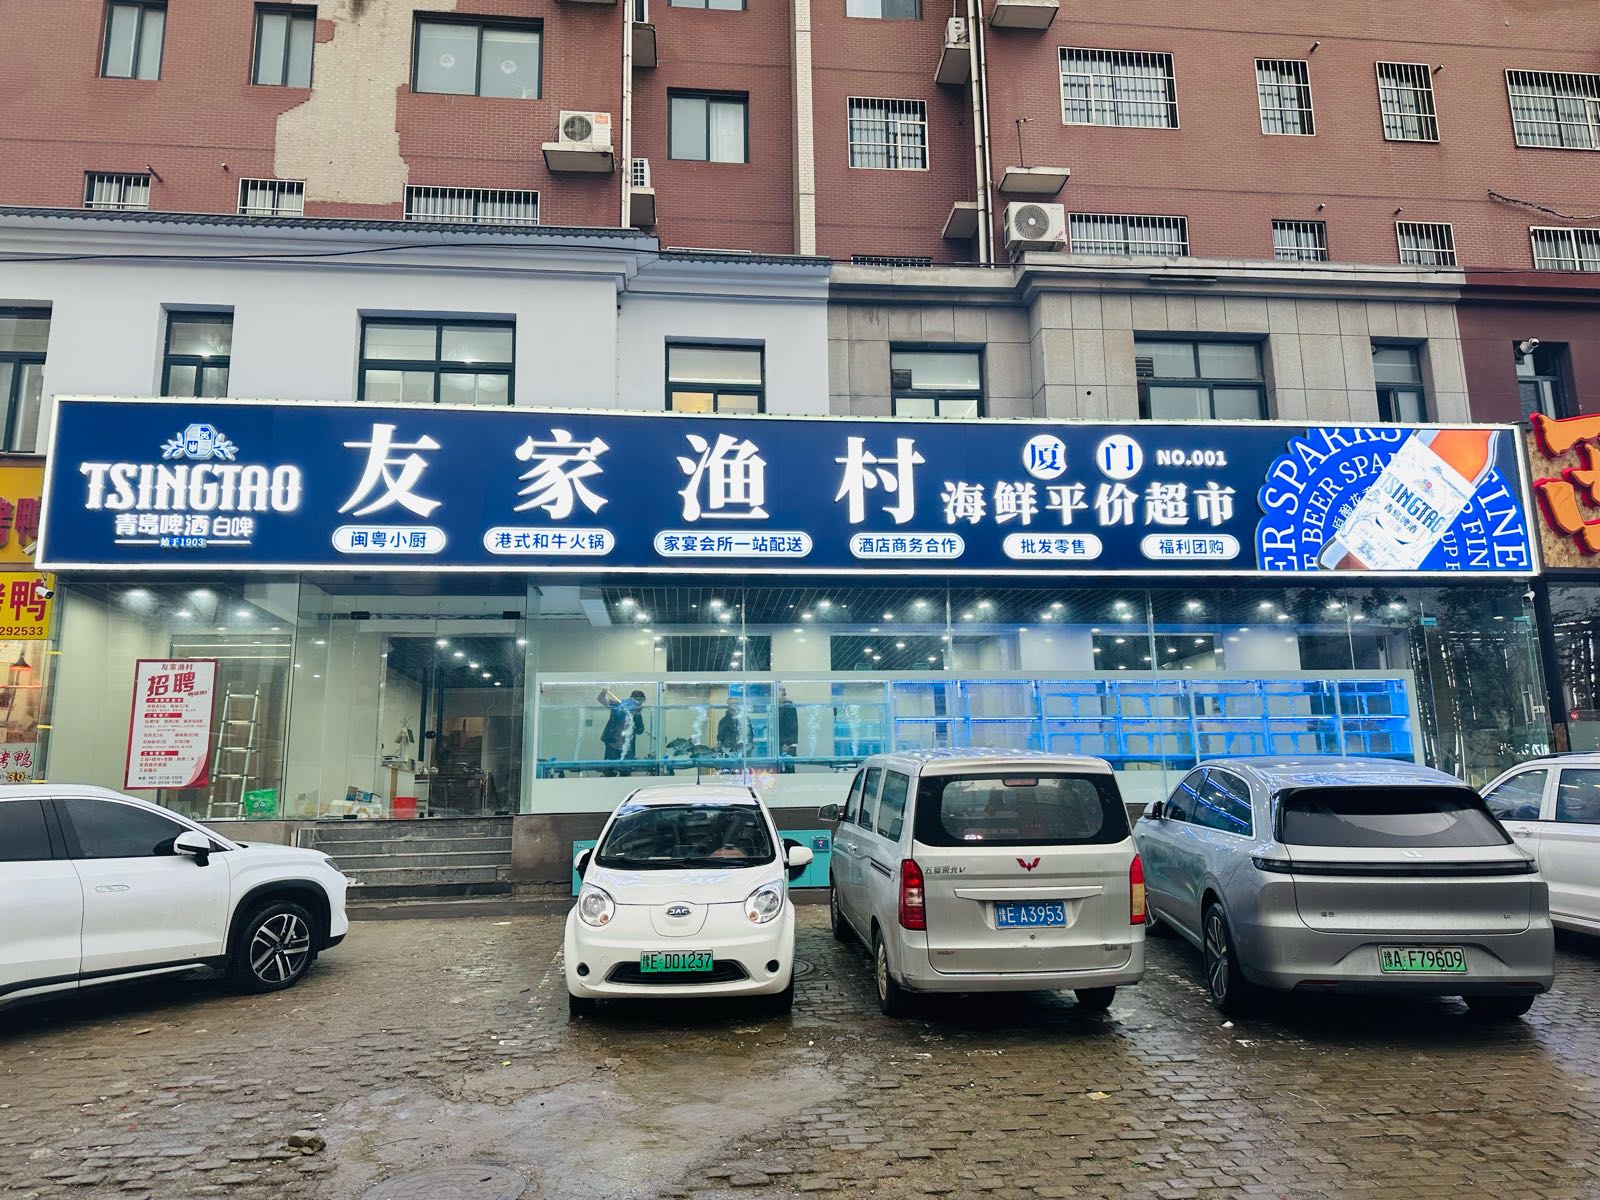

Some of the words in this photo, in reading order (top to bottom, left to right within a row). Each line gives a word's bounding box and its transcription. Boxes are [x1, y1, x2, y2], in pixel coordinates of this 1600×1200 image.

[1030, 443, 1134, 472] 厦门
[1156, 449, 1229, 468] NO.001
[338, 423, 927, 525] 友家渔村
[1339, 452, 1397, 484] SPA
[79, 462, 302, 513] TSINGTAO
[940, 480, 1238, 527] 海鲜平价超市
[350, 531, 427, 548] 闽粤小厨
[494, 532, 605, 550] 港式和牛火锅
[663, 535, 803, 553] 家宴会所一站配送
[858, 537, 957, 554] 酒店商务合作
[1020, 538, 1087, 555] 批发零售
[1158, 538, 1225, 555] 福利团购
[146, 671, 196, 697] 招聘
